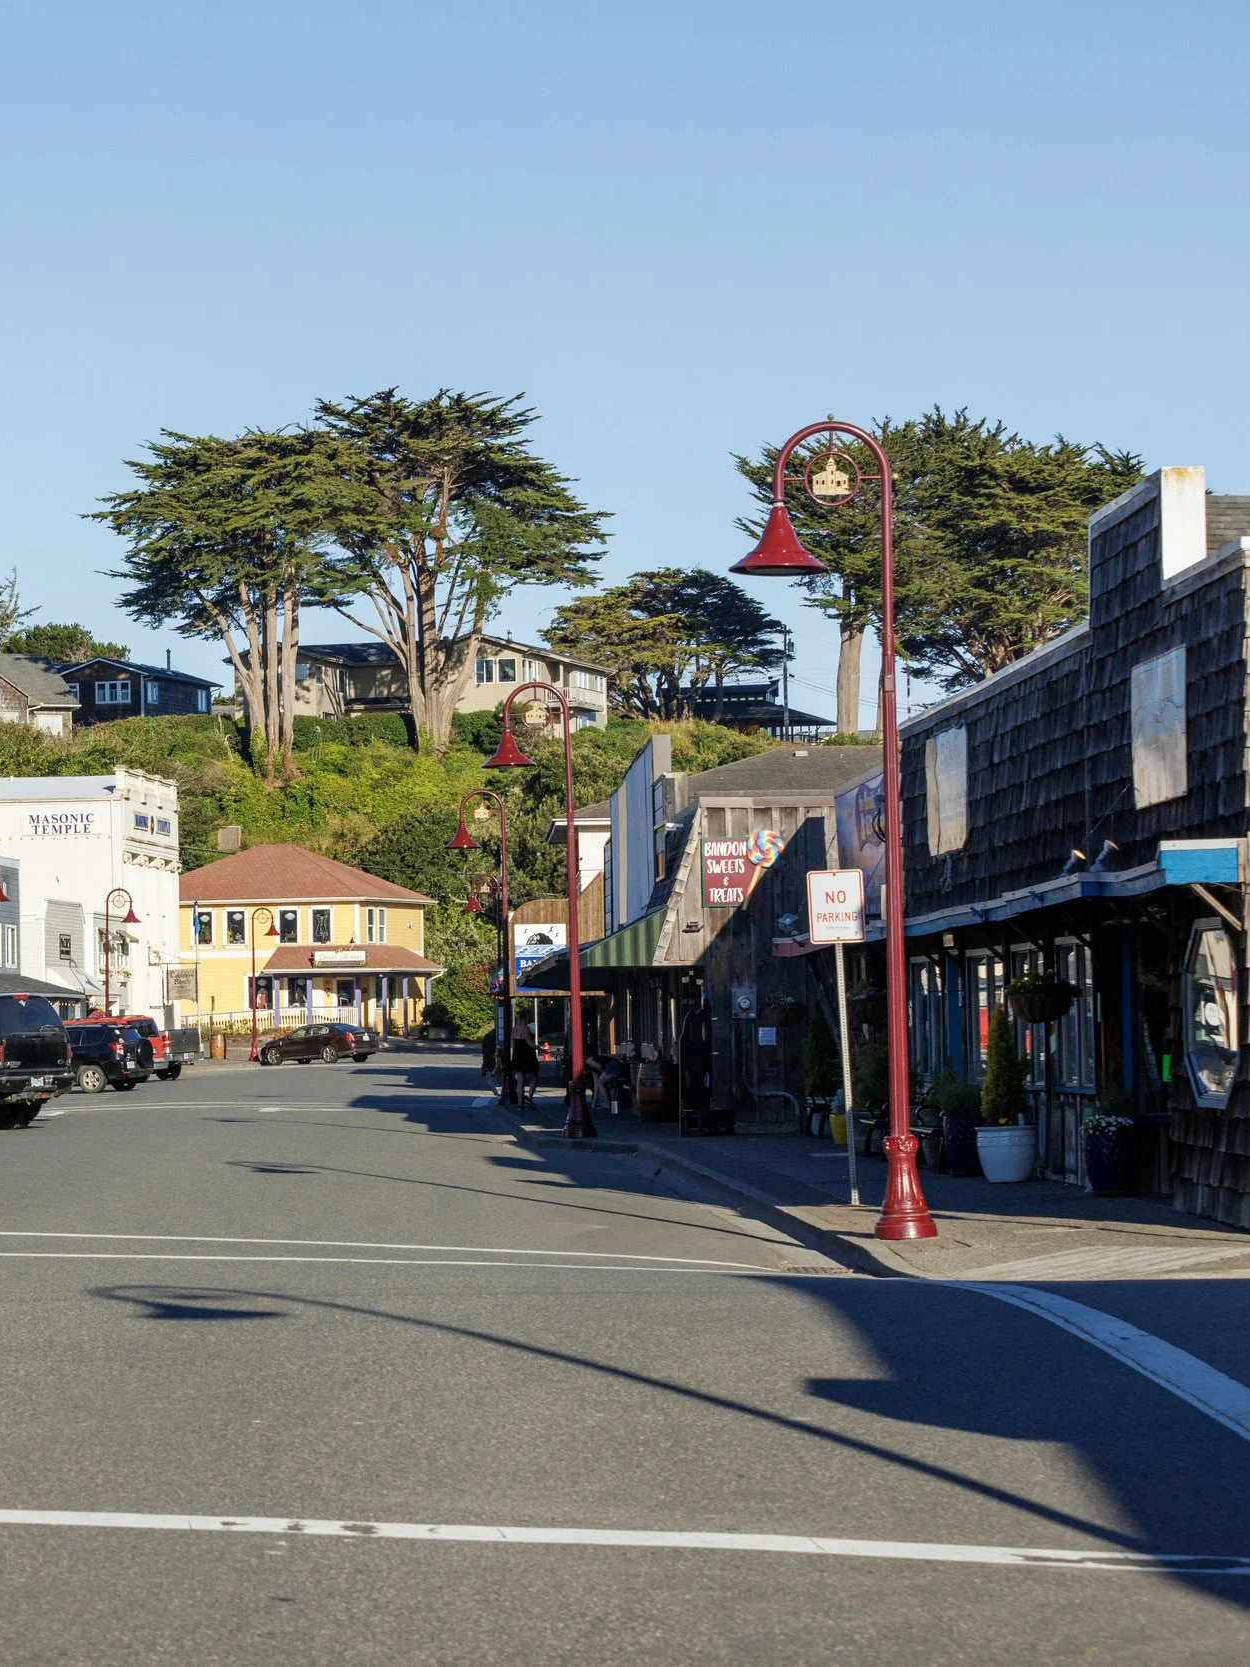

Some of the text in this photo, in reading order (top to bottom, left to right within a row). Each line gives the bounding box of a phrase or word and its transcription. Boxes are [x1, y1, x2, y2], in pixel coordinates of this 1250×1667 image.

[29, 813, 94, 824] MASONIC
[32, 824, 91, 834] TEMPLE
[704, 841, 747, 857] BANDON
[707, 859, 745, 874] SWEETS
[723, 876, 729, 886] &
[709, 887, 744, 903] TREATS
[825, 890, 846, 904] NO
[816, 911, 858, 923] PARKING
